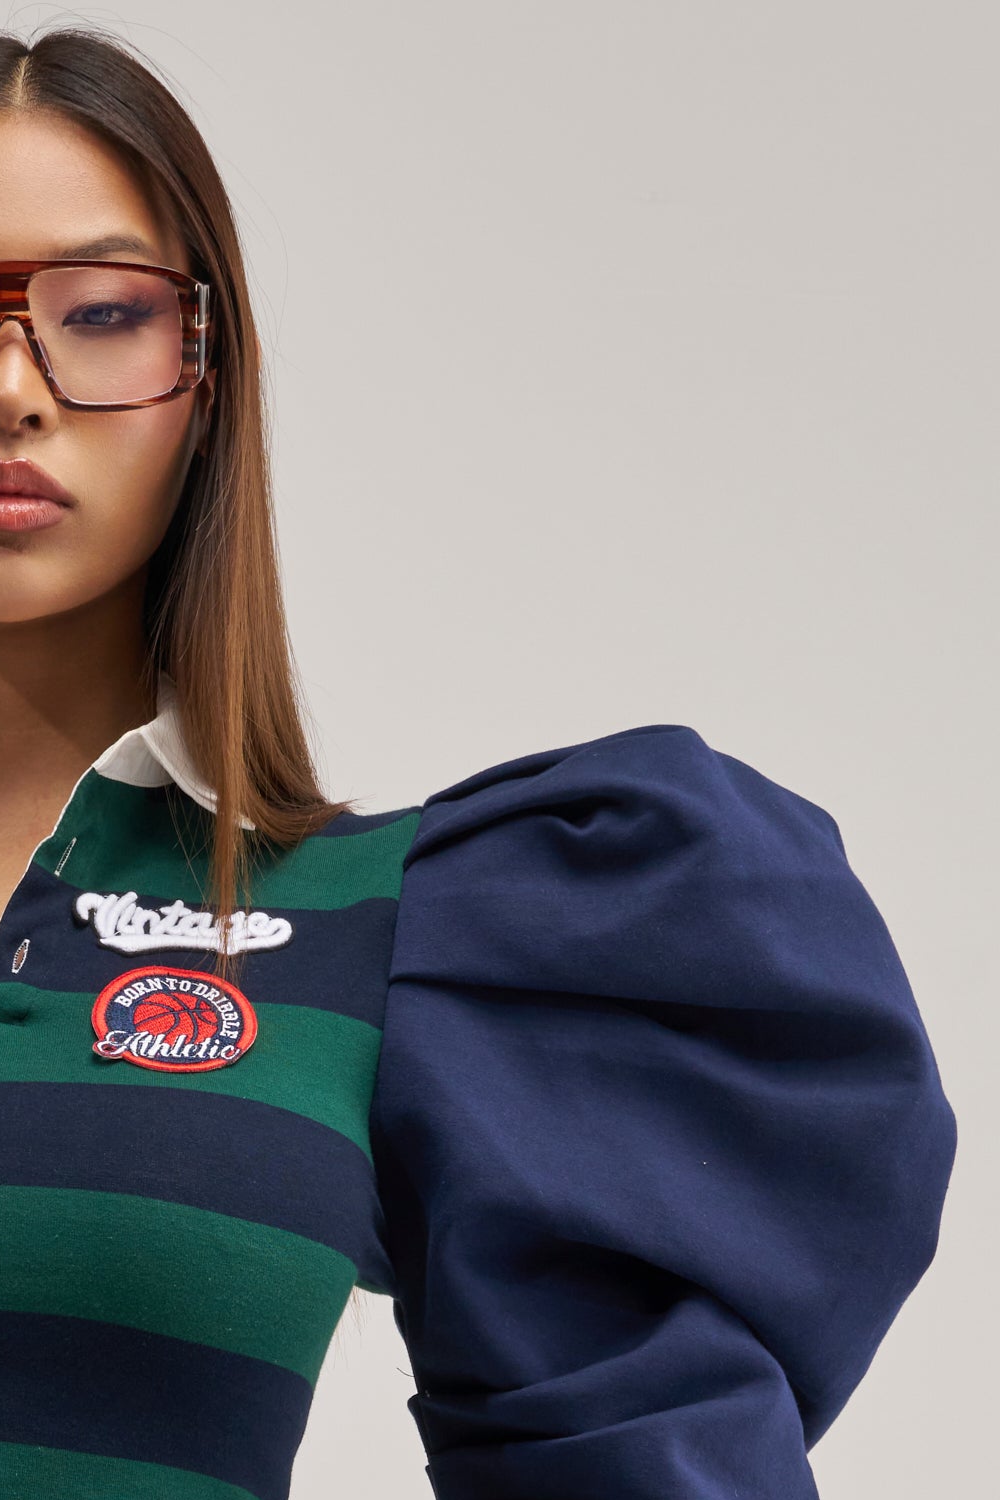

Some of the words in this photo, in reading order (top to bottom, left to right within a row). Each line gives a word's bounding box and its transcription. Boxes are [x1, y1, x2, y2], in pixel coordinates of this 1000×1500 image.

[76, 891, 292, 955] Vintage
[114, 978, 163, 1007] BORN
[166, 978, 191, 991] TO
[192, 983, 240, 1039] DRIBBLE
[97, 1031, 240, 1060] Athletic
